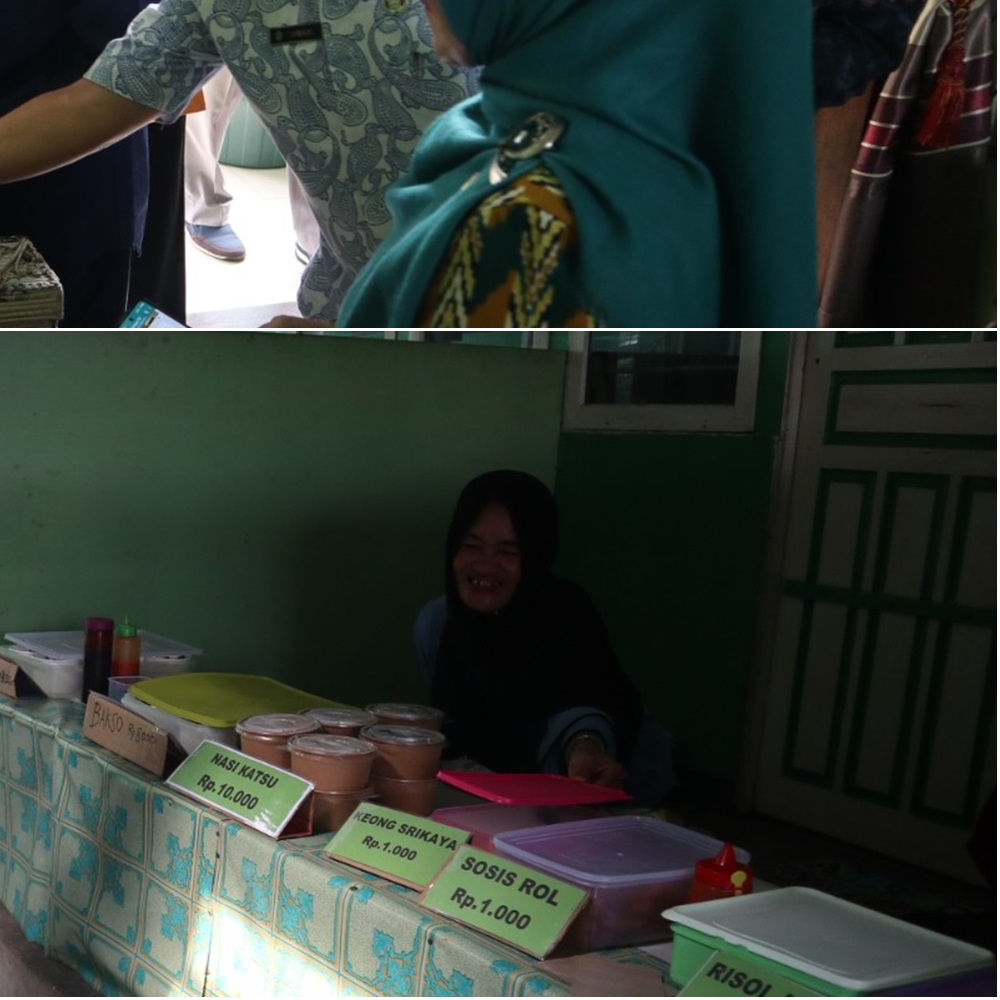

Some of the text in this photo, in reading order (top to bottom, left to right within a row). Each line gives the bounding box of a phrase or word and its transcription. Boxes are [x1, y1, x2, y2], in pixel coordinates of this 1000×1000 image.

[89, 702, 124, 733] BAKSO
[210, 753, 280, 790] NASI KATSU
[197, 774, 260, 811] Rp.10.000
[352, 810, 458, 852] KEONG SRIKAYA
[361, 835, 418, 862] Rp.1.000
[460, 856, 560, 907] SOSIS ROL
[450, 886, 532, 931] Rp.1.000
